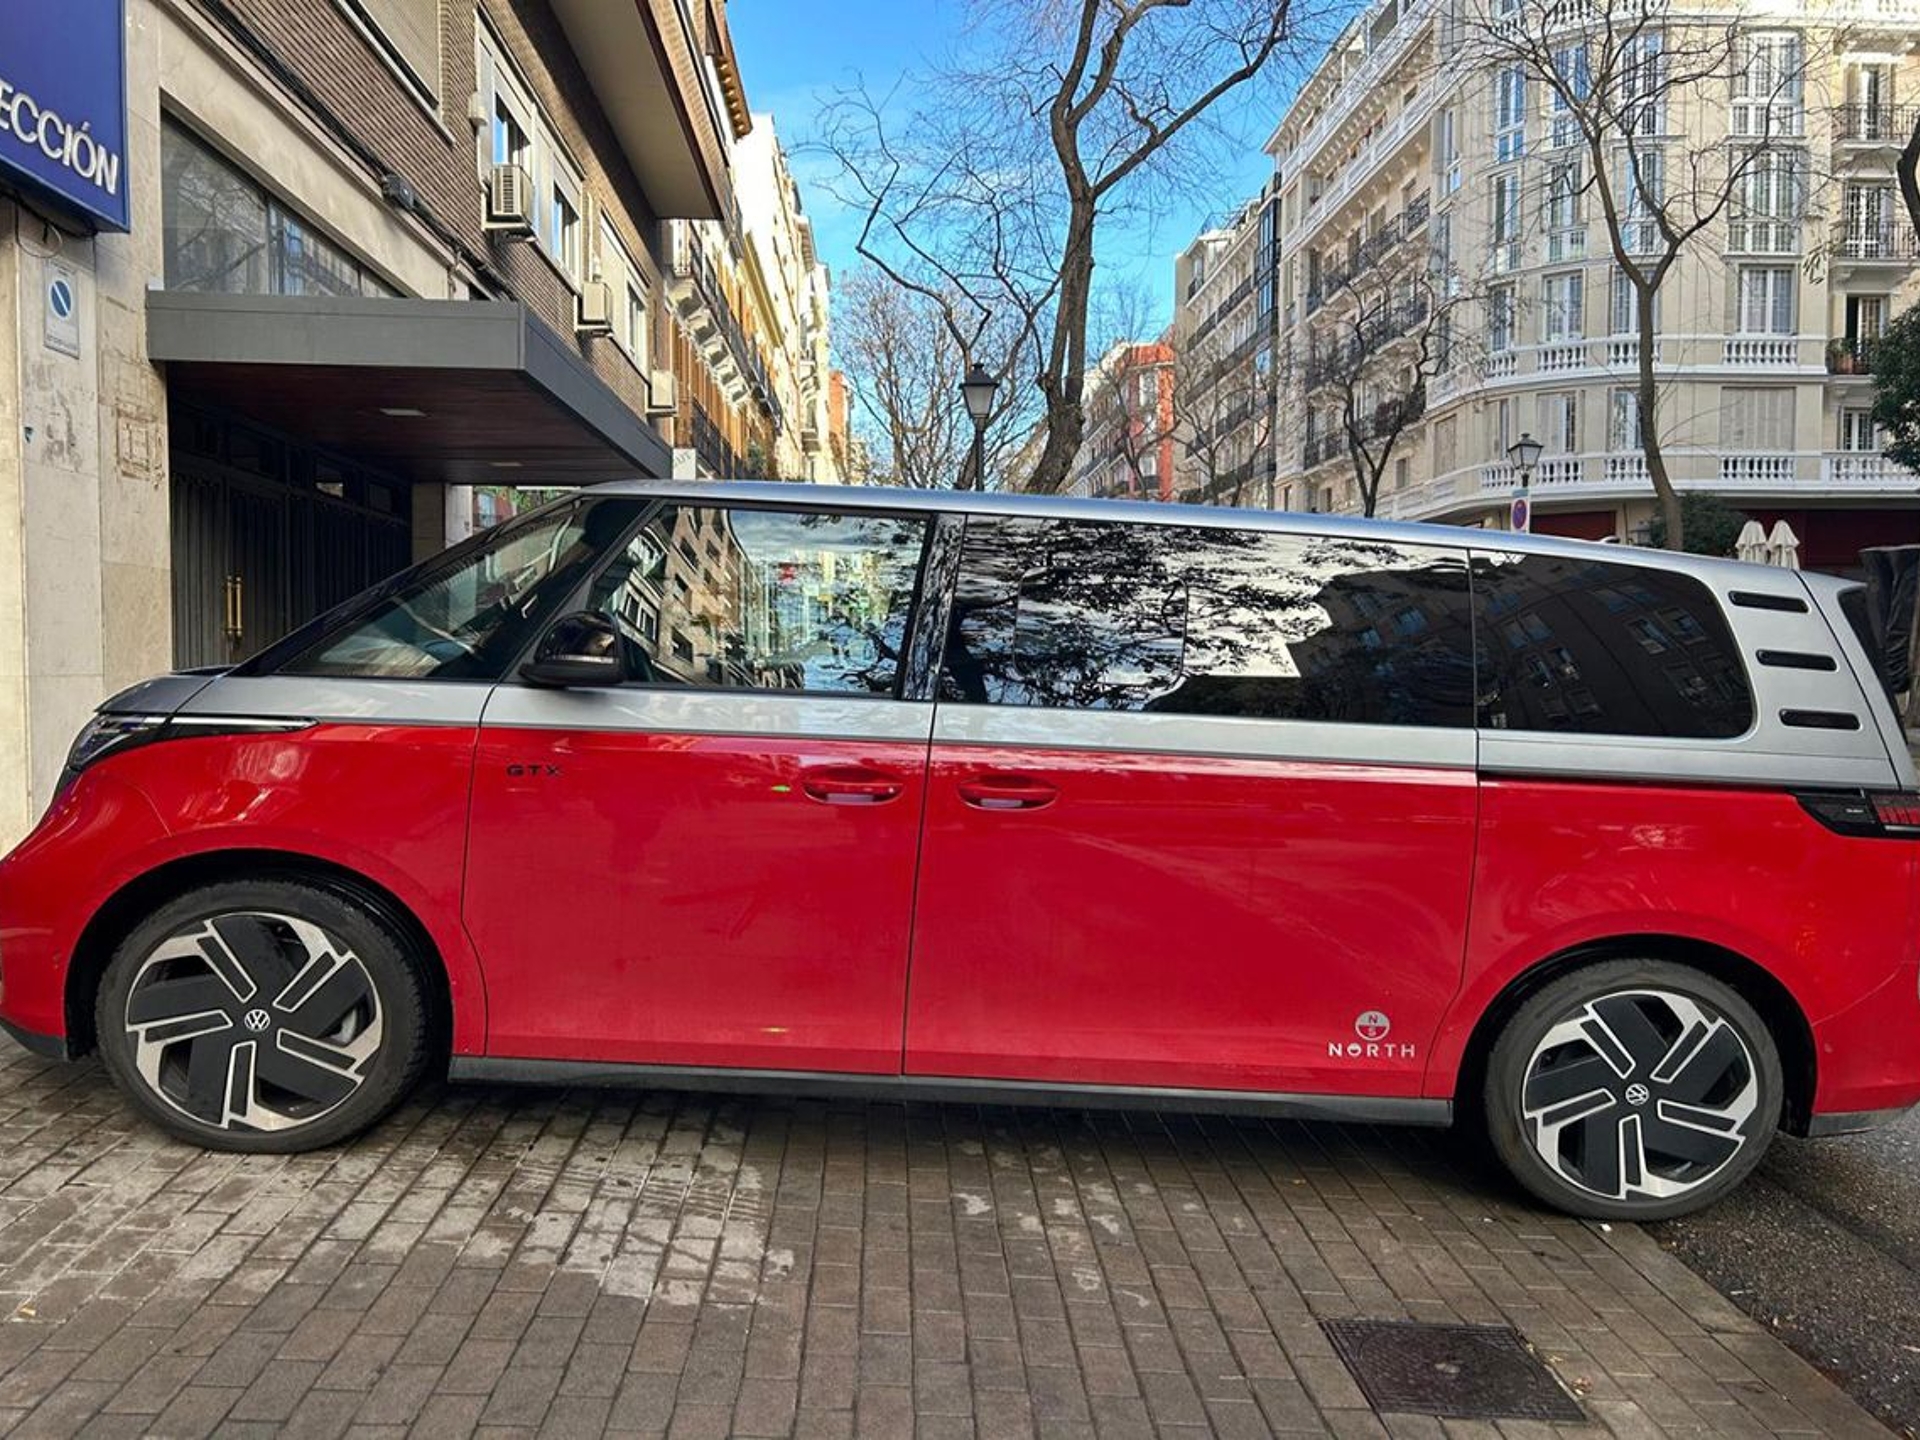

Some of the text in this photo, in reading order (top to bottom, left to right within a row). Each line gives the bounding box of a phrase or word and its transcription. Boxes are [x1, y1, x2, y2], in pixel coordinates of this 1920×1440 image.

[0, 79, 118, 194] ECCIÓN
[506, 764, 561, 776] GTX
[1328, 1042, 1415, 1057] NORTH
